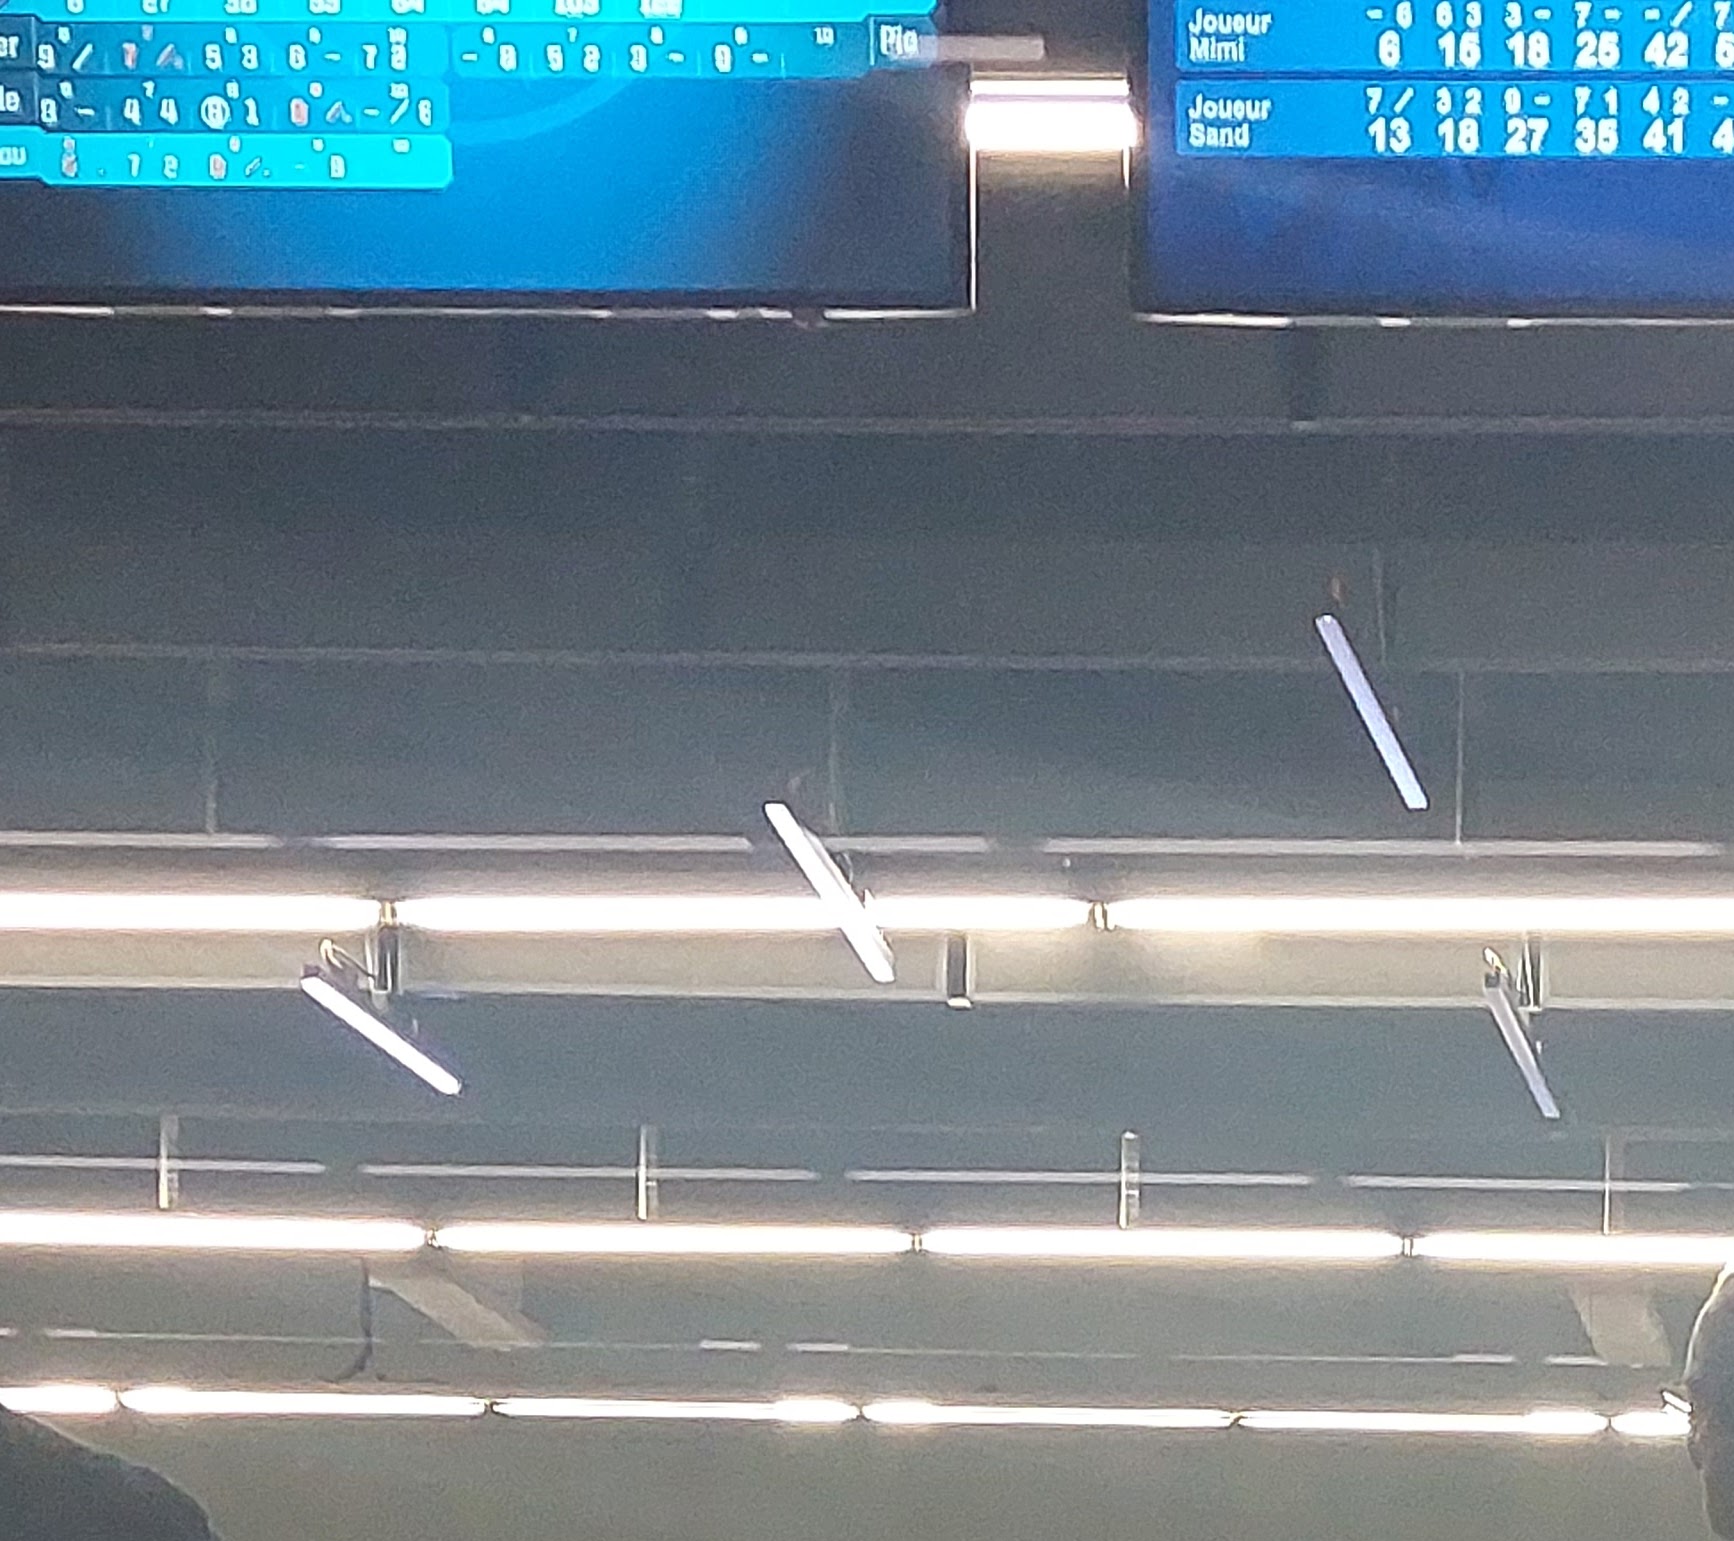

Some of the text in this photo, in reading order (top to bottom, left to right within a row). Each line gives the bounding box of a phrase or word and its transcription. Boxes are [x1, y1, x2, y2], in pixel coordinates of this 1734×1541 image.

[1188, 8, 1272, 35] Joueur
[1189, 36, 1245, 62] Mimi
[1506, 31, 1550, 69] 18
[1644, 31, 1689, 69] 42
[1188, 93, 1272, 120] Joueur
[1189, 122, 1250, 148] Sand
[1368, 117, 1411, 153] 13
[1438, 117, 1479, 154] 18
[1504, 117, 1549, 154] 27
[1643, 117, 1684, 154] 41
